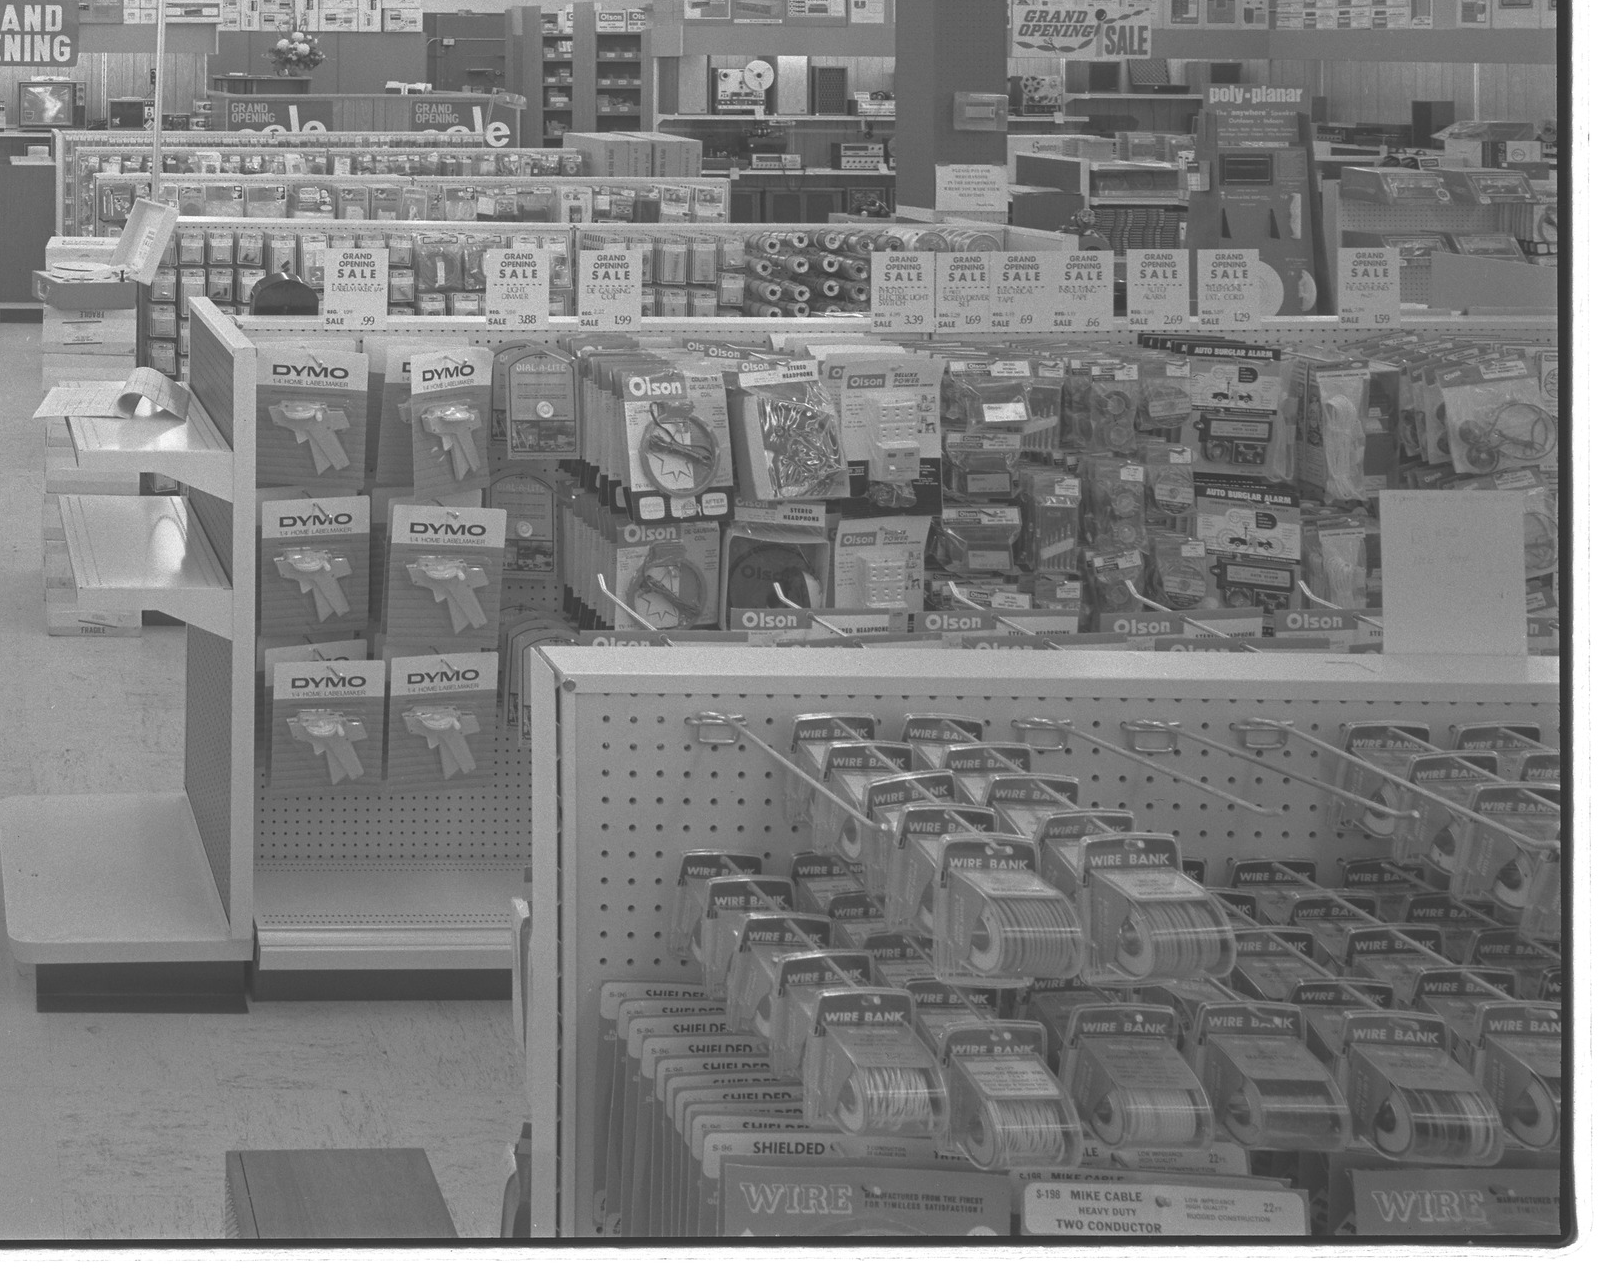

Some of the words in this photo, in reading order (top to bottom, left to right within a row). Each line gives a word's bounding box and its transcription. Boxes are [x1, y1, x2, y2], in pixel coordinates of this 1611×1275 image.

[1023, 10, 1088, 24] GRAND
[1018, 24, 1097, 38] OPENING
[1105, 25, 1149, 56] SALE
[1209, 85, 1303, 104] poly-planar
[232, 103, 268, 113] GRAND
[416, 103, 452, 113] GRAND
[232, 113, 275, 123] OPENING
[416, 113, 459, 123] OPENING
[337, 269, 376, 279] SALE
[499, 269, 538, 279] SALE
[884, 272, 922, 282] SALE
[1002, 272, 1041, 281] SALE
[1140, 270, 1178, 279] SALE
[1351, 268, 1389, 278] SALE
[361, 316, 375, 325] .99
[904, 315, 924, 325] 3.39
[709, 348, 740, 358] Olson
[1194, 347, 1213, 355] AUTO
[1214, 348, 1246, 357] BURGLAR
[1247, 350, 1273, 358] ALARM
[272, 364, 350, 380] DYMO
[422, 364, 475, 382] DYMO
[741, 362, 770, 372] Olson
[787, 364, 807, 372] STEREO
[782, 371, 814, 379] HEADPHONE
[305, 380, 349, 388] LABELMAKER
[629, 376, 682, 397] Olson
[850, 377, 883, 387] Olson
[1206, 487, 1225, 497] AUTO
[1227, 489, 1262, 501] BURGLAR
[1263, 493, 1291, 504] ALARM
[279, 513, 353, 528] DYMO
[410, 522, 486, 537] DYMO
[624, 523, 677, 543] Olson
[843, 536, 874, 545] Olson
[742, 611, 798, 628] Olson
[925, 614, 982, 630] Olson
[1286, 613, 1343, 629] Olson
[1113, 619, 1171, 634] Olson
[291, 676, 367, 689] DYMO
[407, 669, 479, 685] DYMO
[949, 857, 984, 870] WIRE
[989, 858, 1029, 871] BANK
[1090, 855, 1125, 867] WIRE
[1129, 853, 1169, 866] BANK
[824, 1012, 860, 1024] WIRE
[865, 1011, 904, 1022] BANK
[1353, 1028, 1390, 1041] WIRE
[1393, 1030, 1439, 1044] BANK
[712, 1144, 733, 1152] S-96
[753, 1141, 825, 1155] SHIELDED
[740, 1183, 853, 1215] WIRE
[921, 1194, 941, 1203] FROM
[943, 1195, 957, 1204] THE
[959, 1196, 983, 1205] FINEST
[1036, 1189, 1061, 1200] S-198
[1070, 1190, 1100, 1202] MIKE
[1104, 1191, 1143, 1203] CABLE
[1078, 1206, 1110, 1216] HEAVY
[1112, 1207, 1137, 1217] DUTY
[1371, 1190, 1485, 1222] WIRE
[1055, 1219, 1083, 1230] TWO
[1084, 1220, 1162, 1234] CONDUCTOR
